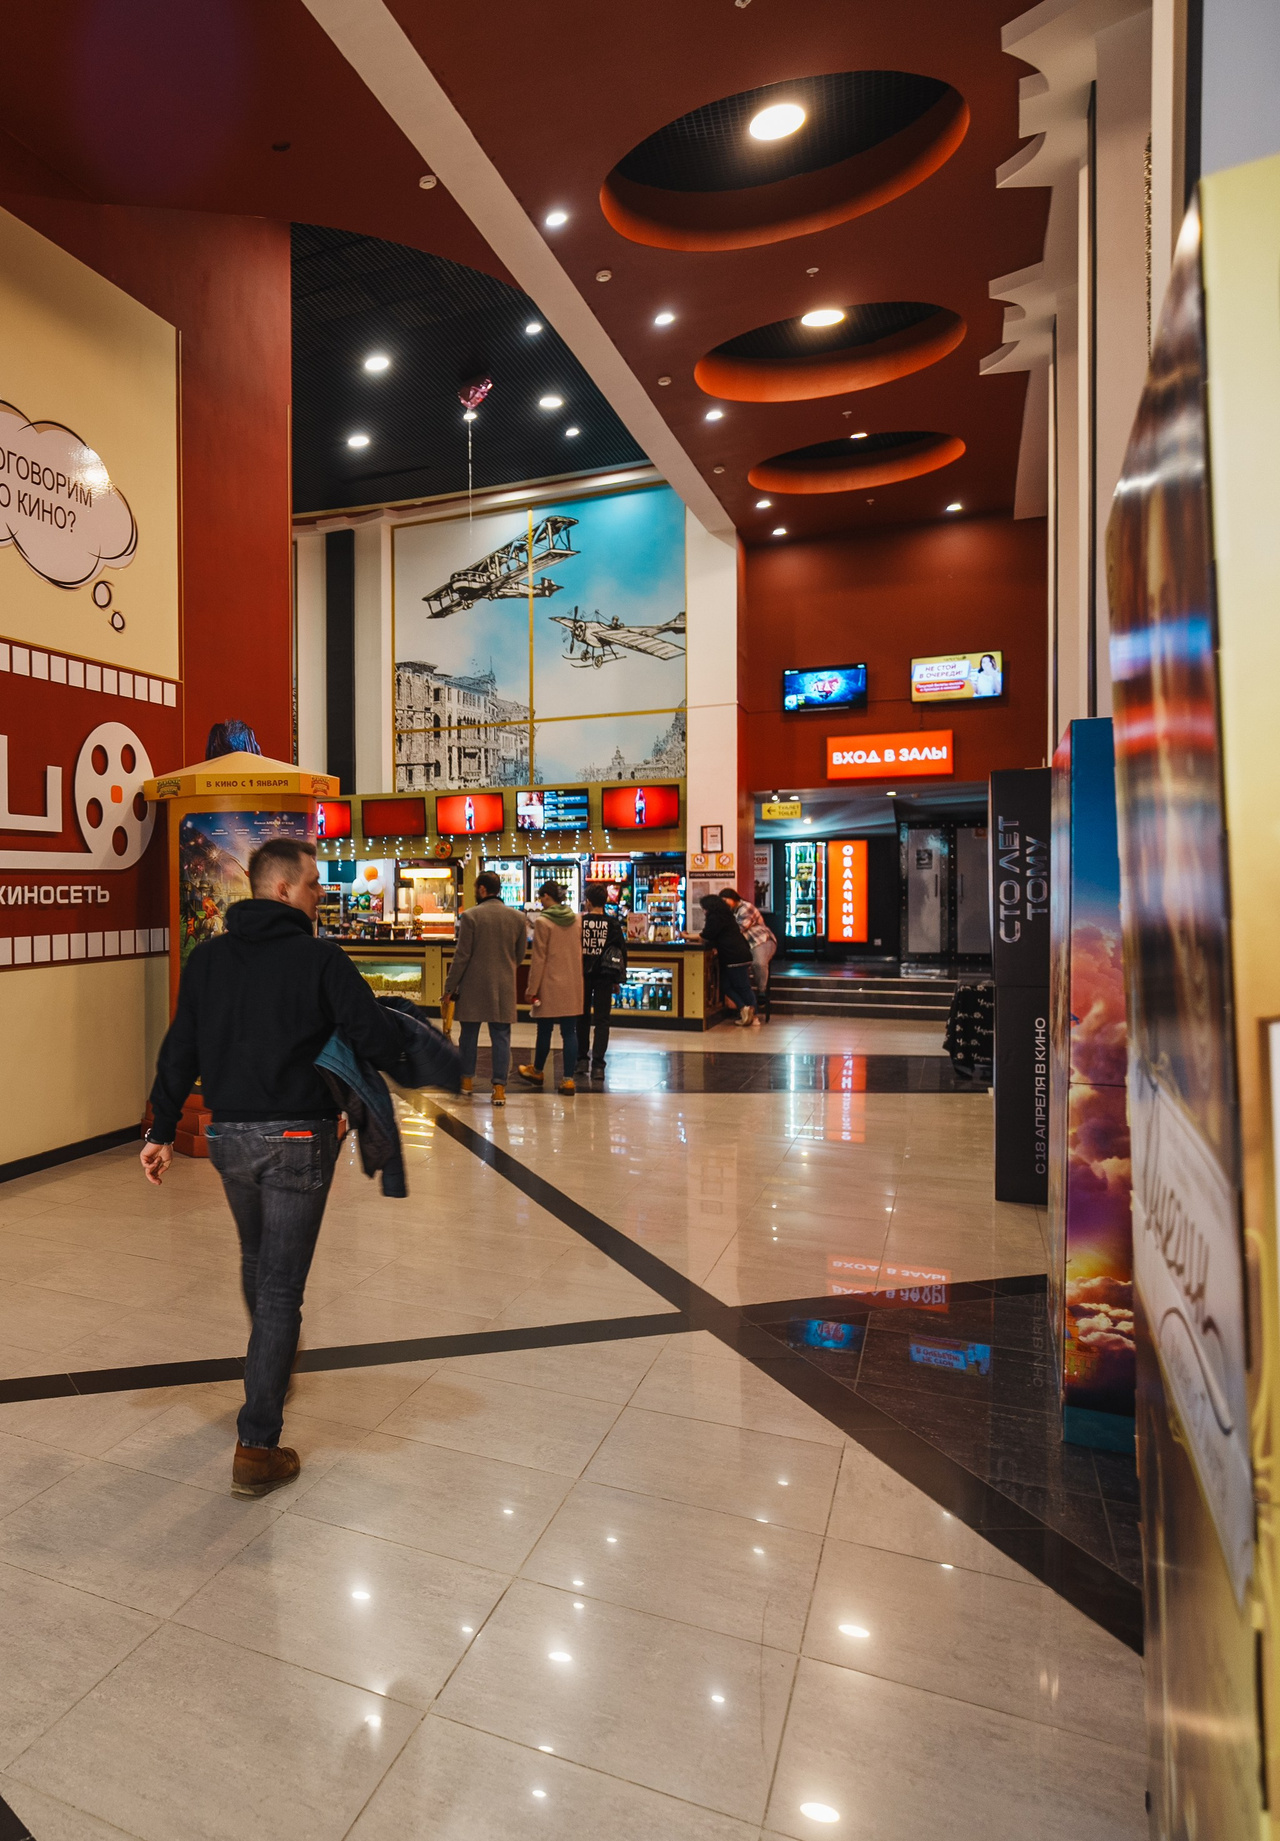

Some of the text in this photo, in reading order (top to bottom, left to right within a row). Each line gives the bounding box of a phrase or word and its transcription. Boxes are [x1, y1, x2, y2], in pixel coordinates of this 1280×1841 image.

[17, 489, 77, 533] КИНО?
[832, 745, 948, 765] ВХОД В ЗАЛЫ
[206, 780, 212, 788] В
[215, 780, 239, 788] КИНО
[249, 779, 254, 787] 1
[256, 779, 289, 787] ЯНВАРЯ
[998, 815, 1021, 945] СТО ЛЕТ
[1025, 835, 1048, 921] ТОМУ
[582, 929, 608, 938] IS THE
[583, 919, 609, 930] FOUR
[582, 938, 607, 948] NEW
[1035, 1017, 1046, 1175] С 18 АПРЕЛЯ В КИНО
